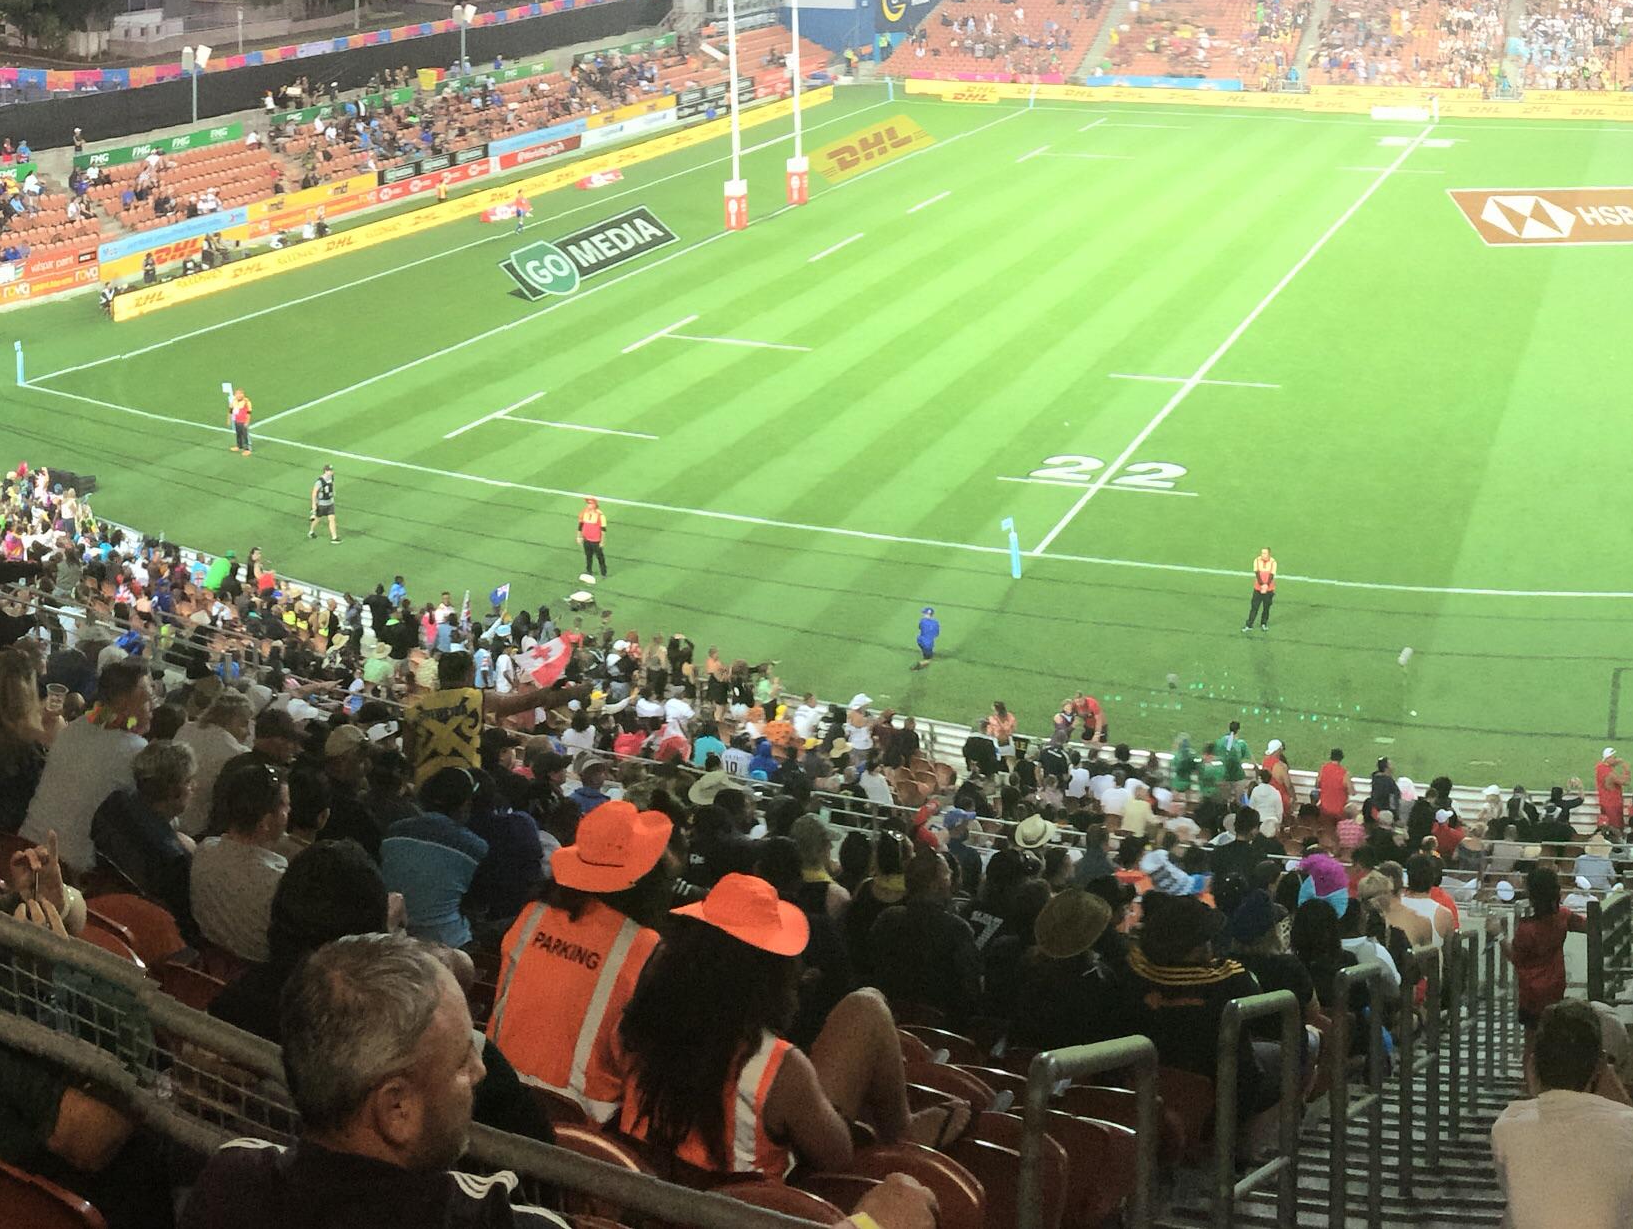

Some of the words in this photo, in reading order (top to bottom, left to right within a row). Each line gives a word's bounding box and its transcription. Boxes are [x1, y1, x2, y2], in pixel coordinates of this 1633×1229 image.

[90, 153, 110, 165] FMG
[133, 145, 152, 157] FMG
[173, 136, 191, 148] FMG
[825, 126, 913, 172] DHL
[525, 254, 571, 285] GO
[566, 217, 665, 268] MEDIA
[1027, 453, 1190, 490] 22
[534, 930, 602, 971] PARKING
